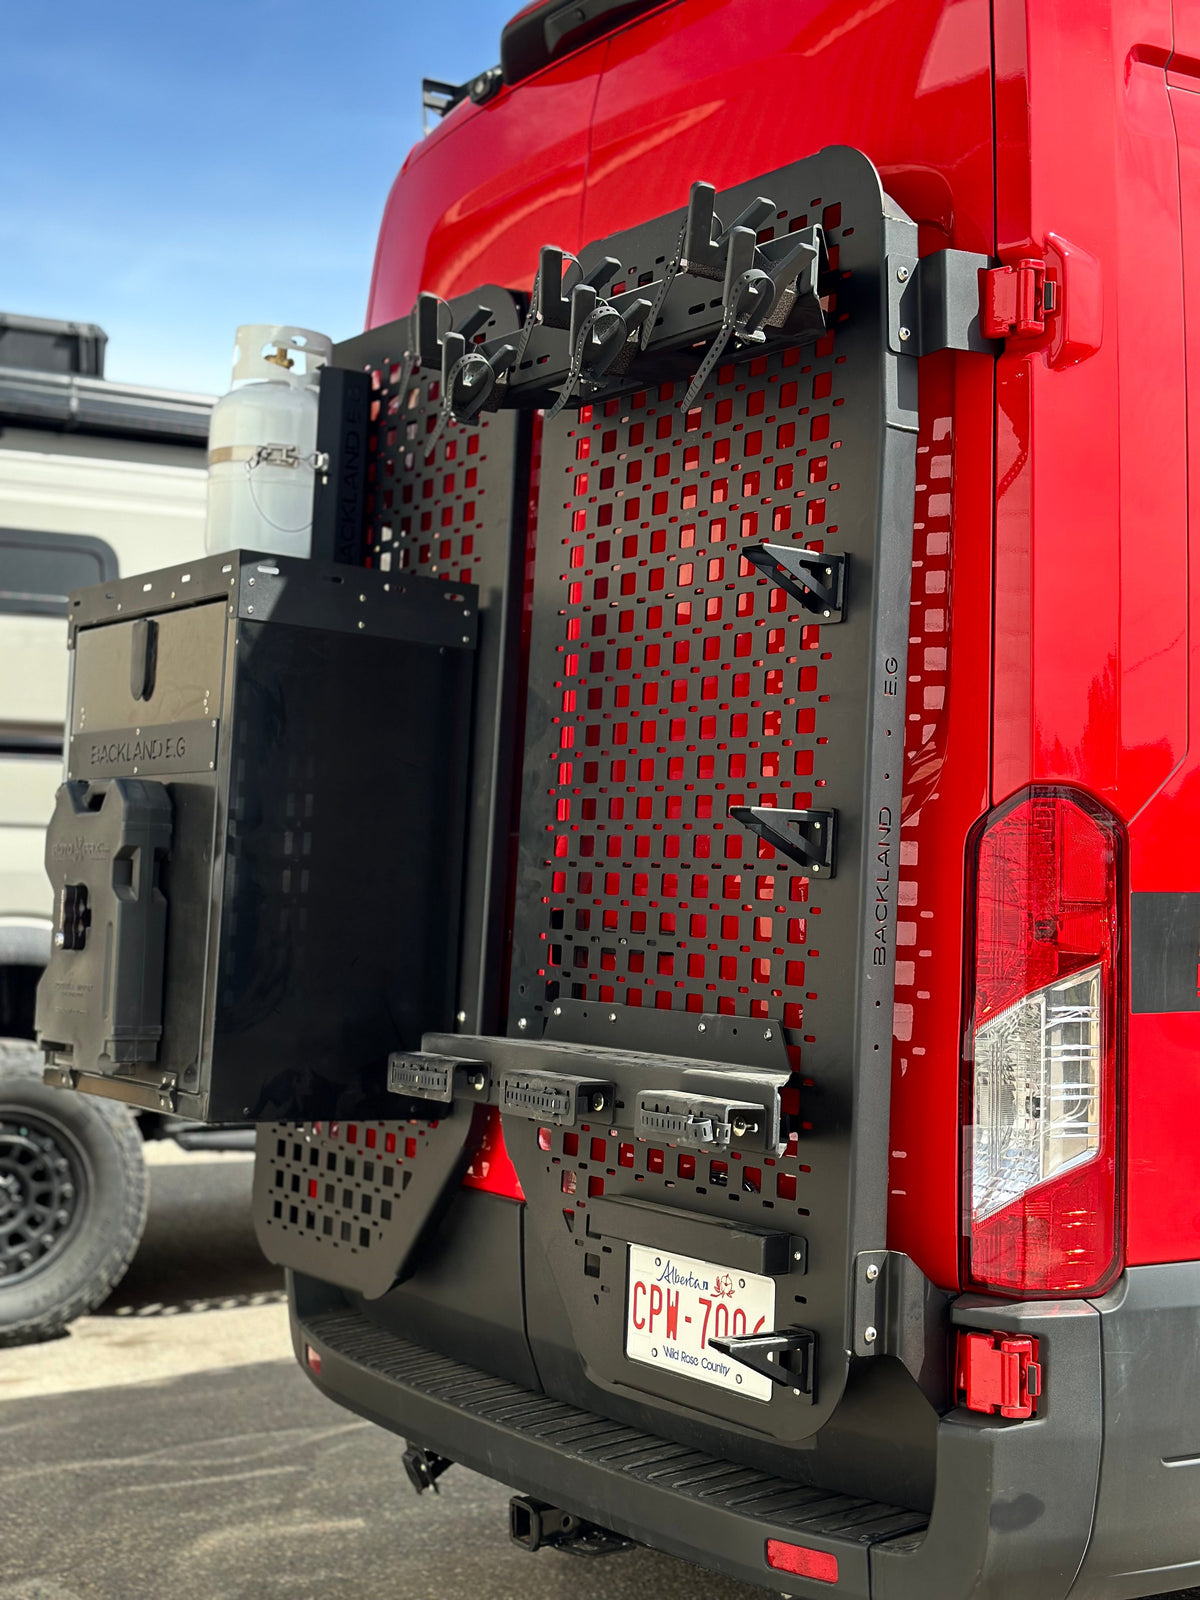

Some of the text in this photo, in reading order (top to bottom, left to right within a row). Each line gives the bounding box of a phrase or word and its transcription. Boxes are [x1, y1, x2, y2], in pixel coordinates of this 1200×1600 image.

[339, 431, 361, 563] ACKLAND
[91, 739, 163, 765] BACKLAND
[872, 656, 898, 967] BACKLAND E.G
[663, 1345, 731, 1376] Wild Rose Country
